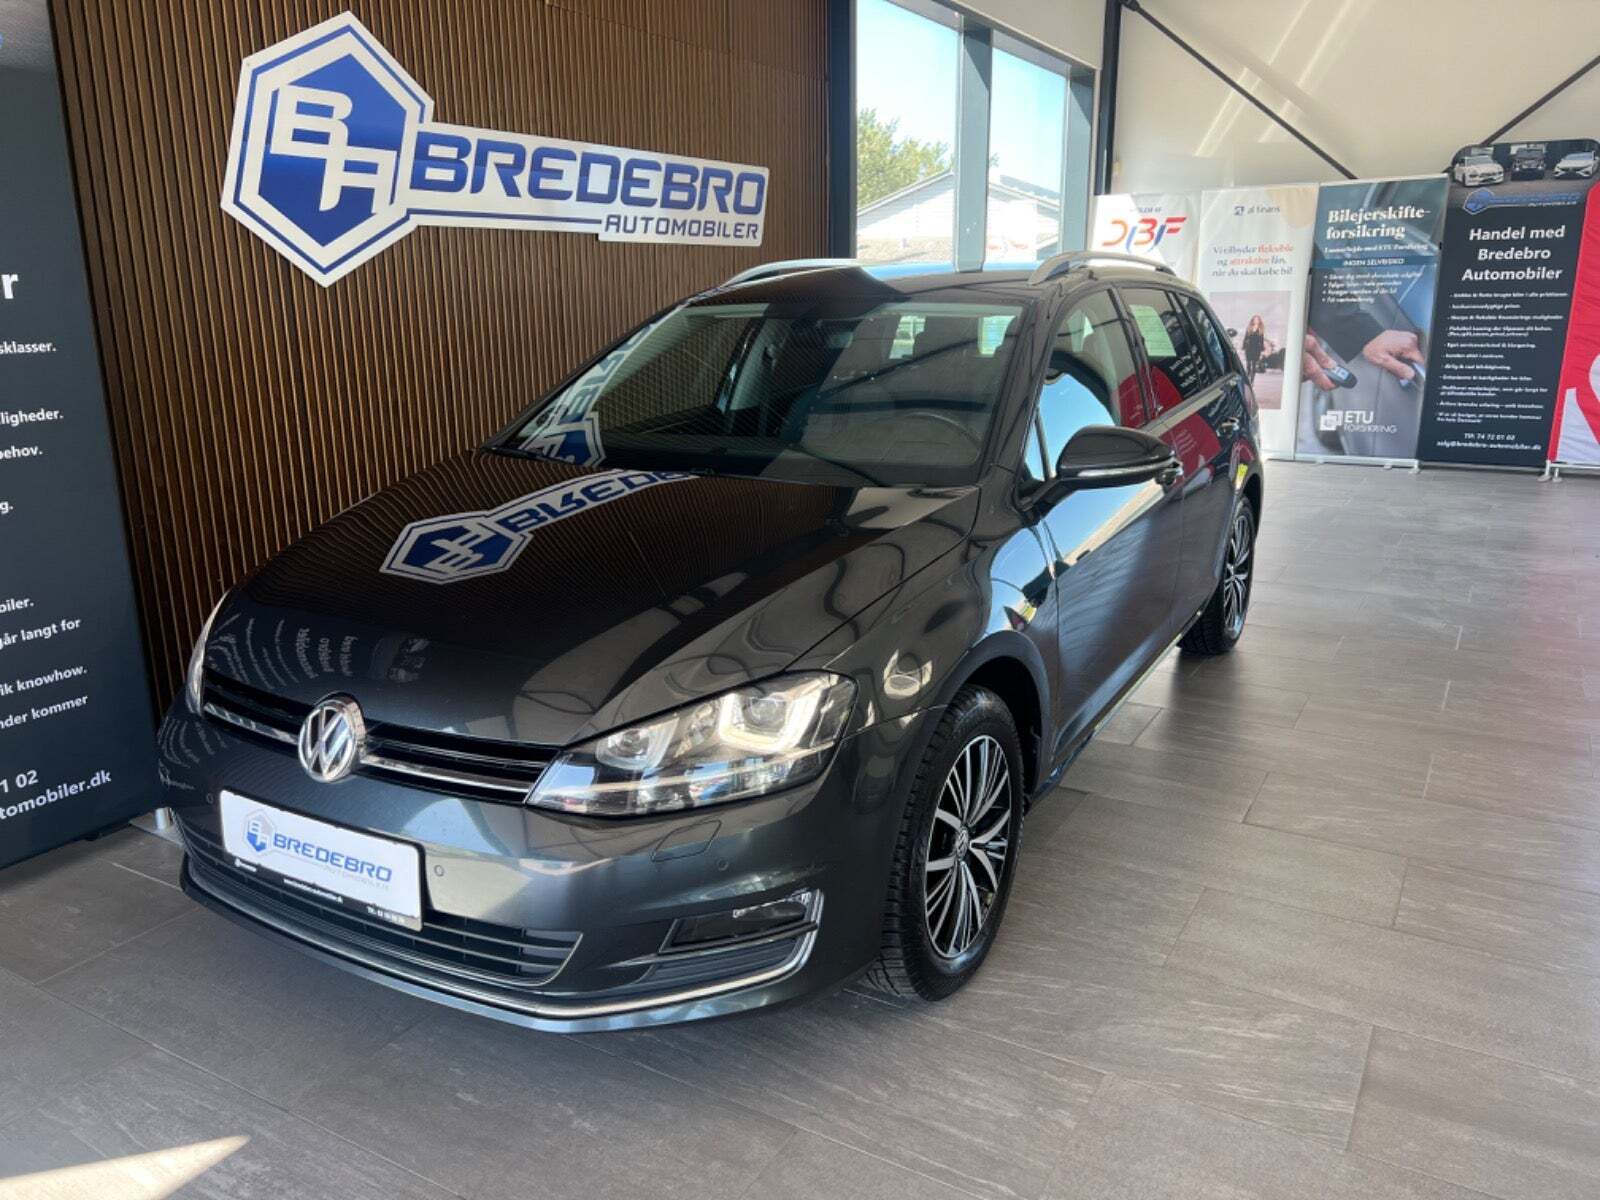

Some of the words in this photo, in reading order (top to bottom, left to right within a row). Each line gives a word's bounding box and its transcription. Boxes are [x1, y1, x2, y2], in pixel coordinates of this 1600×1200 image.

[410, 130, 767, 215] BREDEBRO
[1327, 205, 1432, 225] Bilejerskifte-
[604, 215, 760, 241] AUTOMOBILER
[1326, 223, 1406, 240] forsikring
[1469, 226, 1526, 242] Handel
[1530, 225, 1566, 239] med
[1477, 247, 1552, 261] Bredebro
[1462, 266, 1564, 281] Automobiler
[1, 273, 20, 300] r
[1345, 410, 1374, 425] ETU
[20, 623, 58, 641] langt
[60, 618, 81, 632] for
[16, 665, 88, 692] knowhow.
[31, 695, 88, 720] kommer
[15, 769, 39, 789] 02
[0, 769, 112, 820] tomobiler.dk
[273, 832, 393, 883] BREDEBRO
